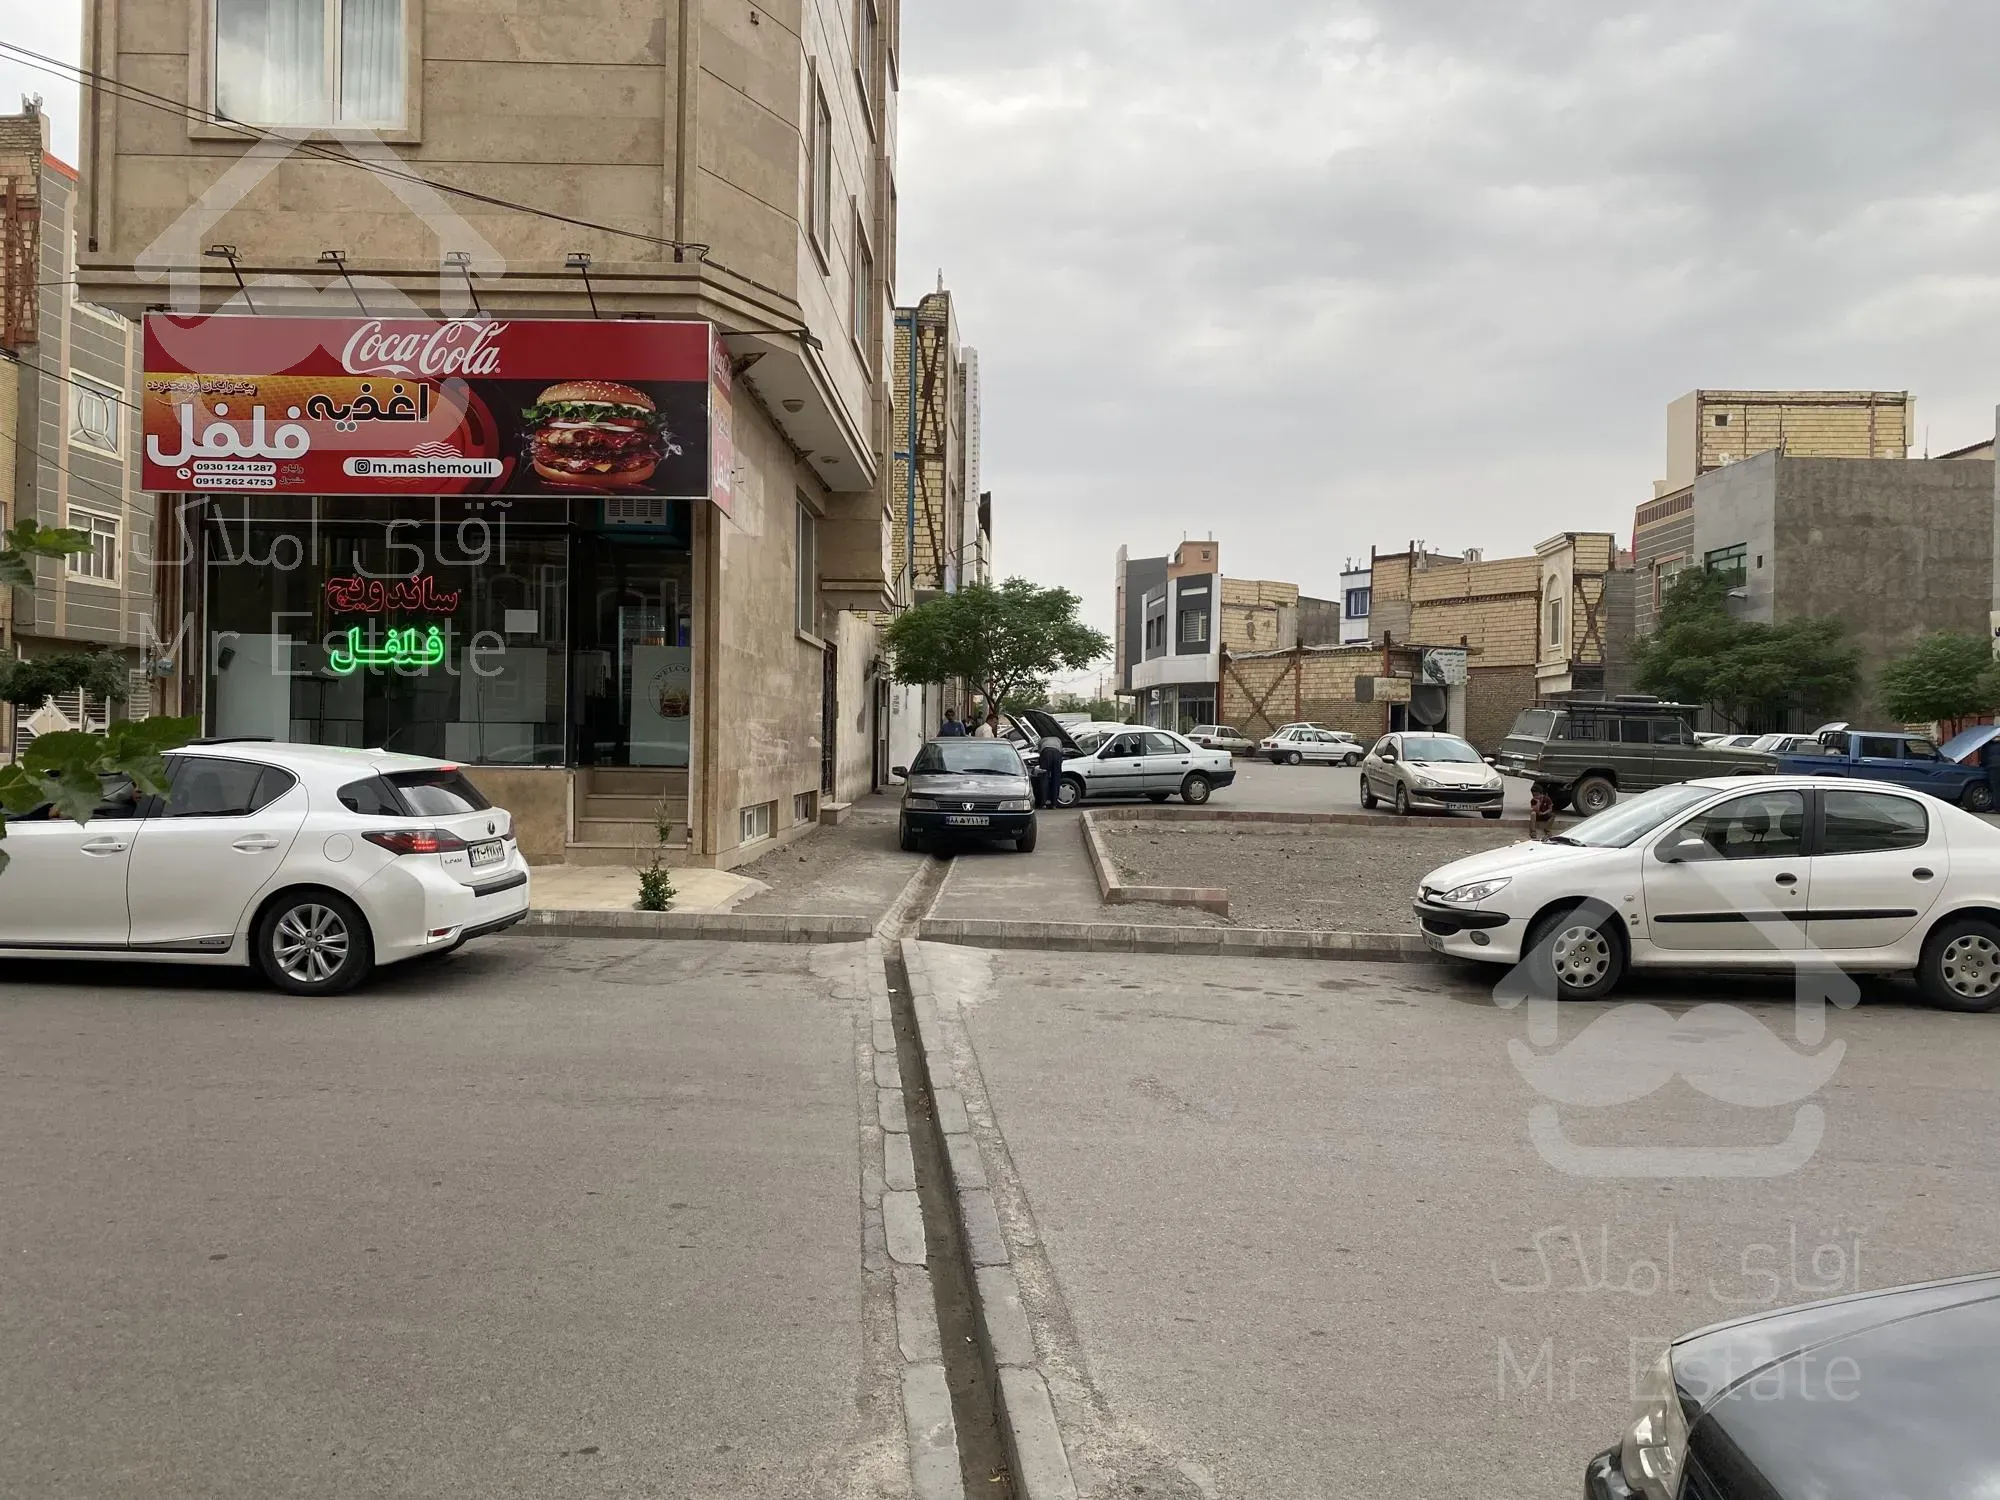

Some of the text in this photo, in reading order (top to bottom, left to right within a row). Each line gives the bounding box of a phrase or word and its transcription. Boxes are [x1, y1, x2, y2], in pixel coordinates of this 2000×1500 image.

[342, 320, 510, 376] Coca-Cola
[201, 379, 234, 393] رایگان
[235, 380, 257, 395] پیک
[306, 382, 430, 433] اغذیه
[146, 402, 311, 467] فلفل
[196, 463, 223, 471] 0930
[247, 464, 273, 472] 1287
[372, 461, 492, 475] m.mashemoull
[195, 477, 222, 485] 0915
[246, 478, 273, 486] 4753
[327, 575, 458, 612] ساندویچ
[330, 626, 444, 673] فلفل
